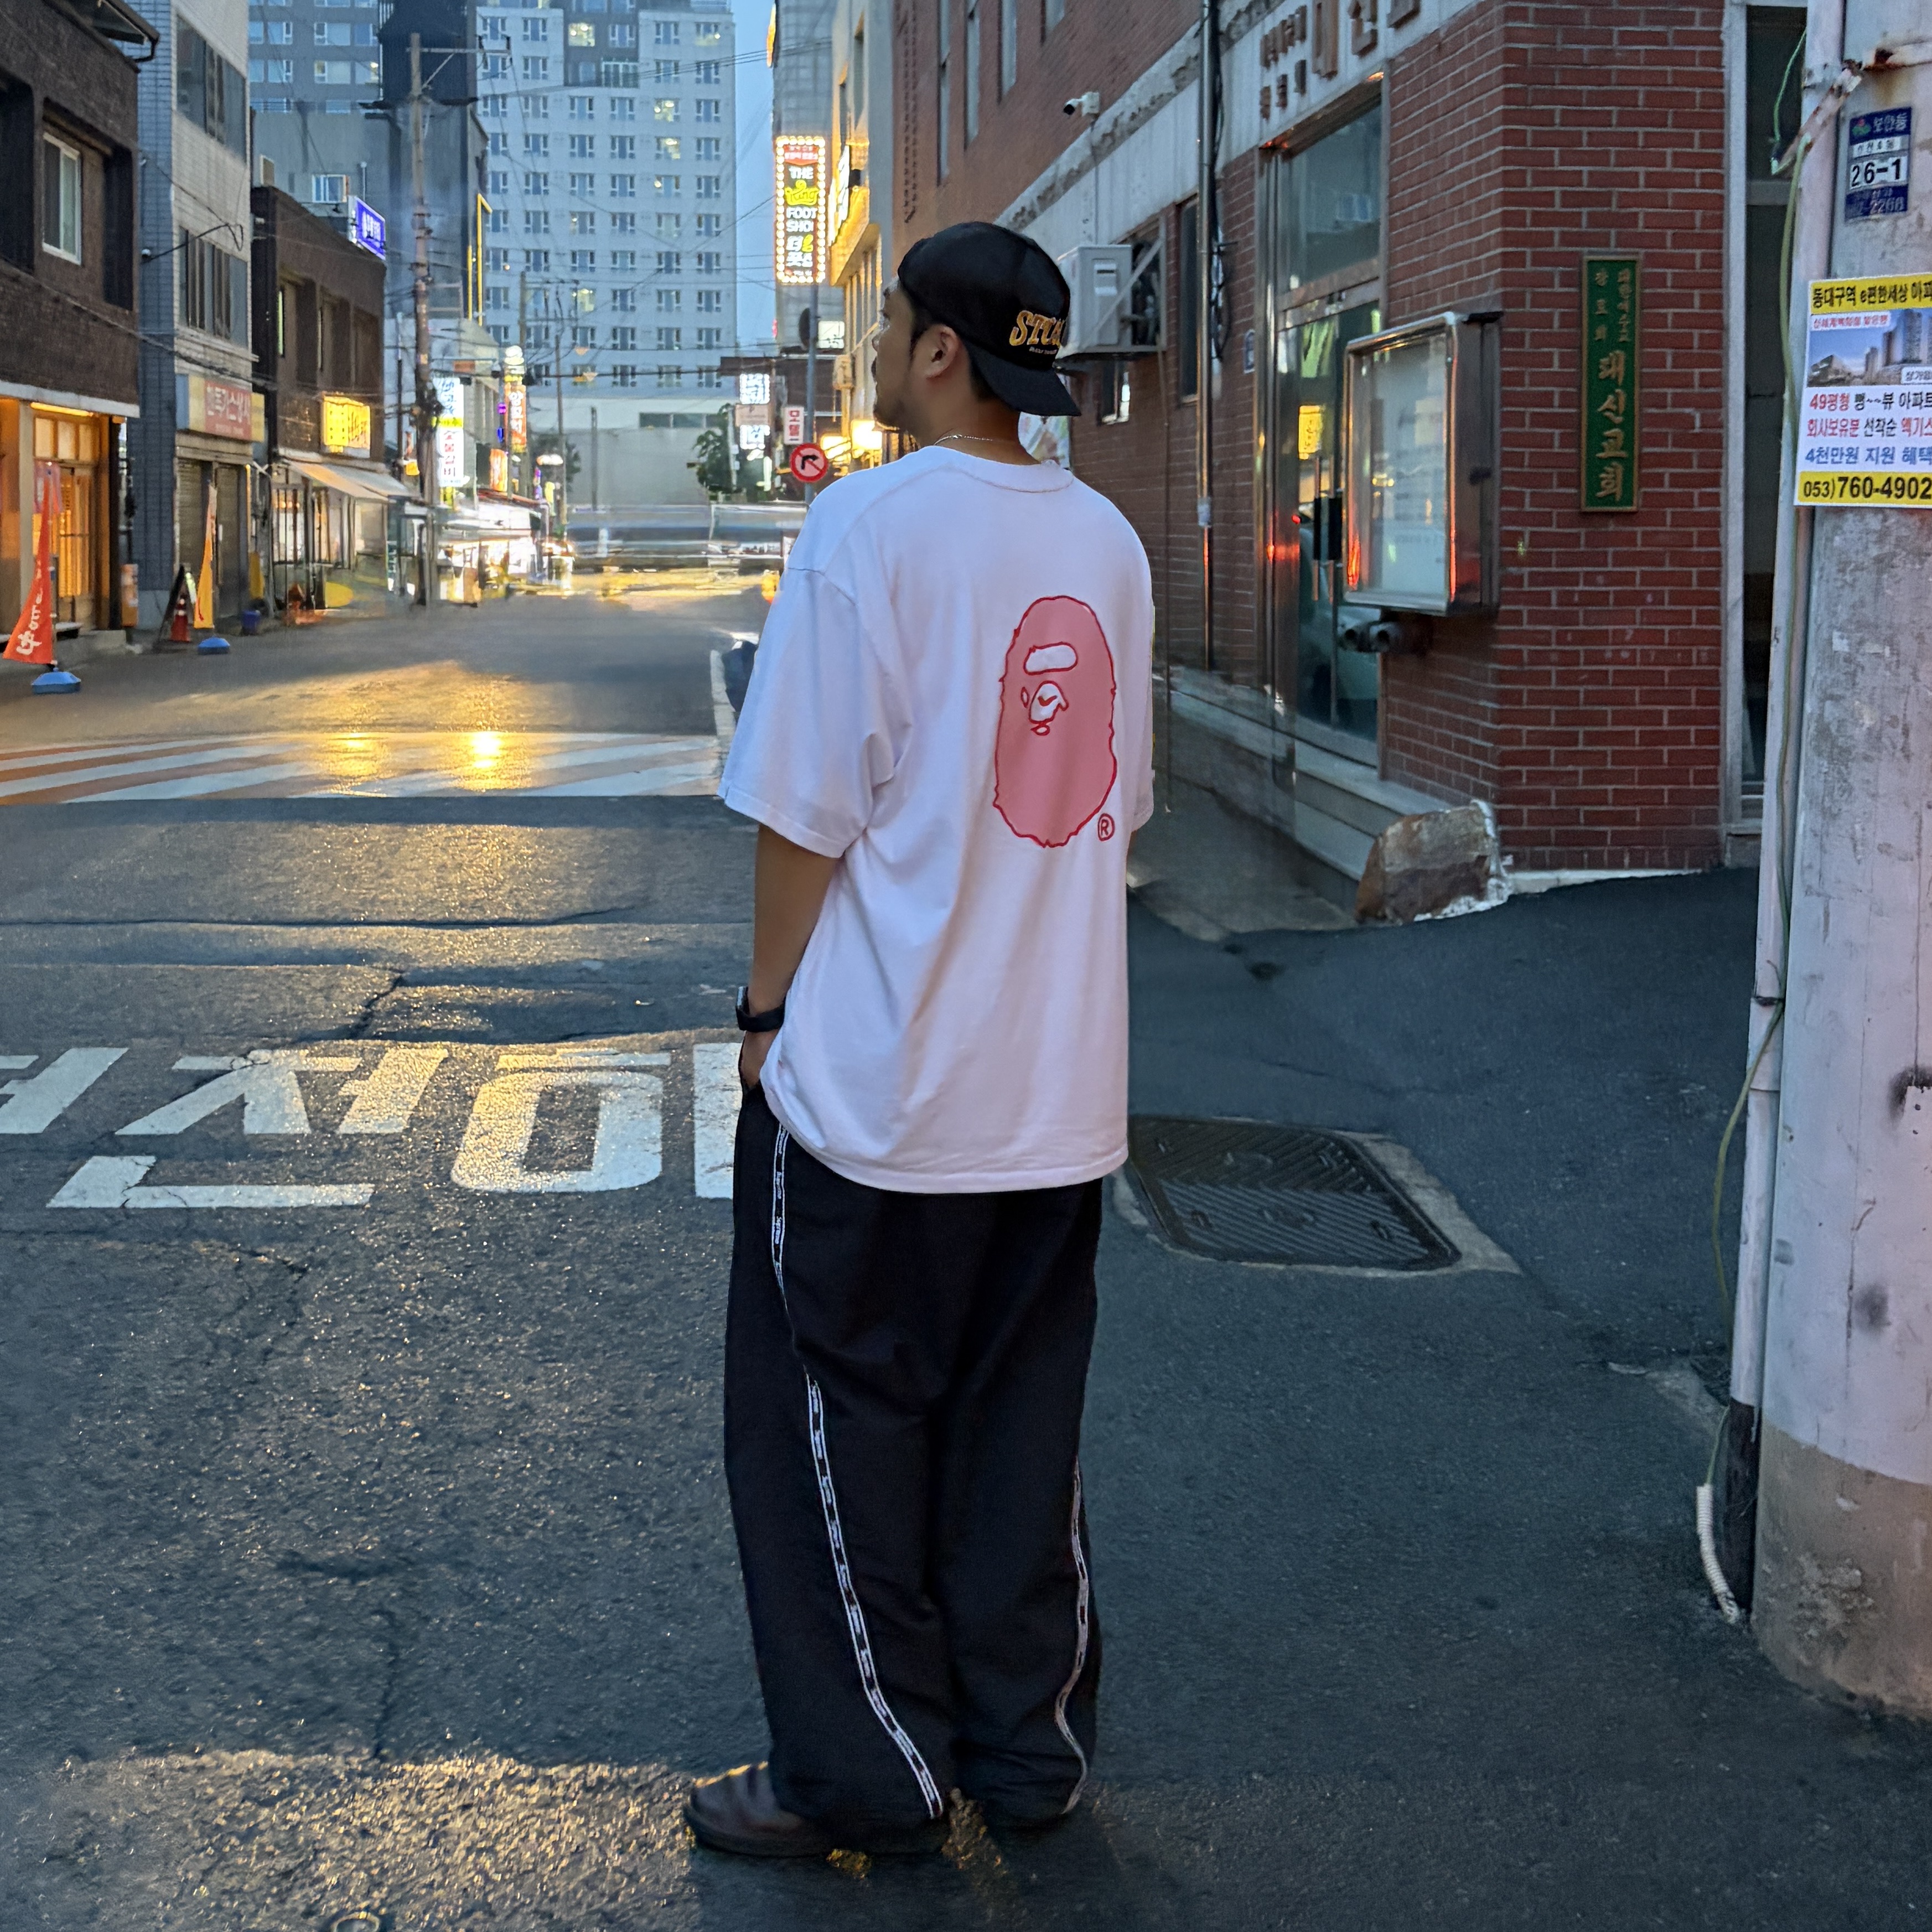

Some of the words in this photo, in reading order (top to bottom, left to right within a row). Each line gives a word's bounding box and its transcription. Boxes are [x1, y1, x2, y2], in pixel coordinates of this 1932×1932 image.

[789, 166, 814, 179] THE
[1851, 159, 1900, 187] 26-1
[786, 207, 818, 219] FOOT
[1813, 286, 1856, 308] 동대구역
[1860, 283, 1908, 304] e편한세상
[1807, 417, 1860, 438] 회사보유분
[1864, 417, 1897, 437] 선착순
[1805, 446, 1860, 464] 4천만원
[1865, 446, 1895, 465] 지원
[1902, 446, 1932, 465] 혜택
